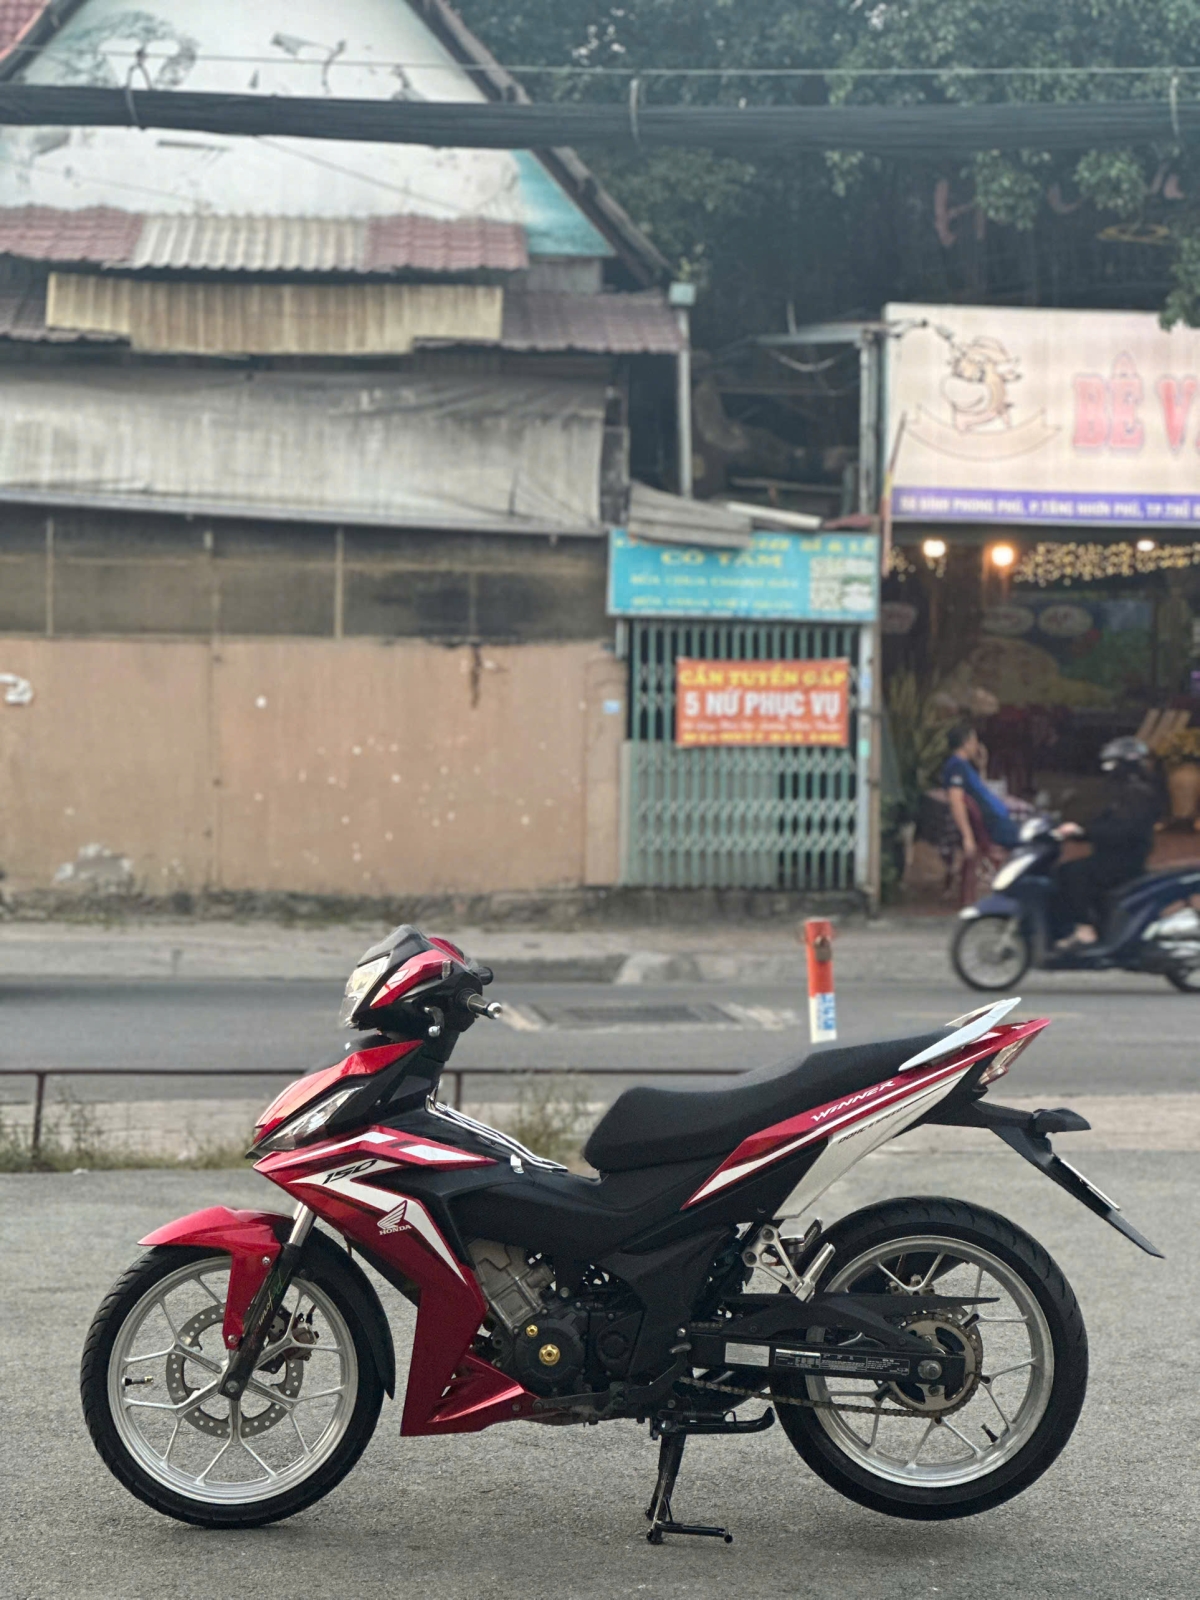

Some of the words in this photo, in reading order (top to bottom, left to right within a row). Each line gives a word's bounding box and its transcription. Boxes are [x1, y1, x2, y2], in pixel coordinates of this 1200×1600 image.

[684, 690, 700, 717] 5
[744, 690, 805, 722] PHỤC
[810, 691, 840, 722] VỤ
[811, 1080, 895, 1121] WINNER
[322, 1159, 378, 1185] 150
[379, 1224, 412, 1235] HONDA
